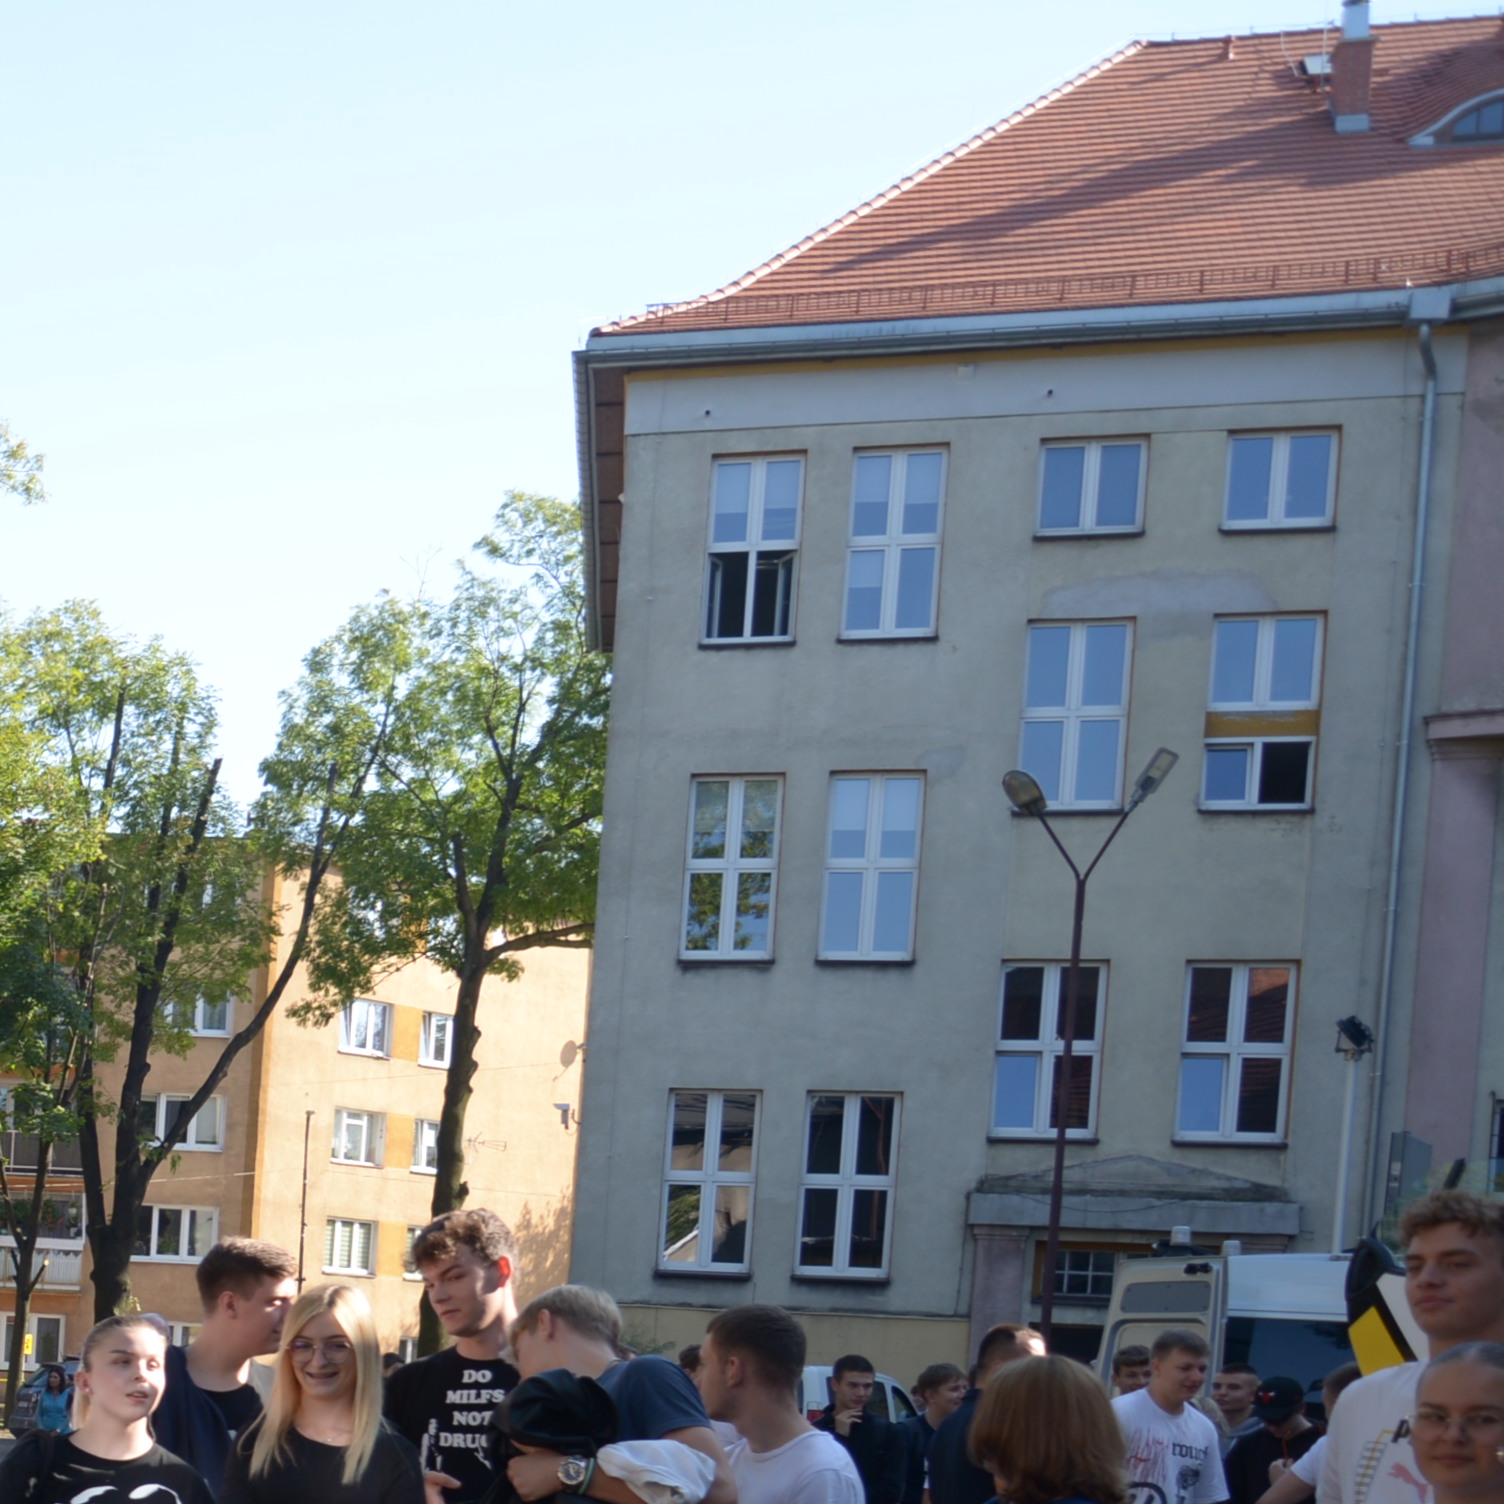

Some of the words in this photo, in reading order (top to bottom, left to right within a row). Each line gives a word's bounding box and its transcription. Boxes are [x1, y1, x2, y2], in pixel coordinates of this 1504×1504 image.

[461, 1369, 493, 1383] DO
[445, 1388, 506, 1404] MILFS
[452, 1411, 494, 1426] NOT
